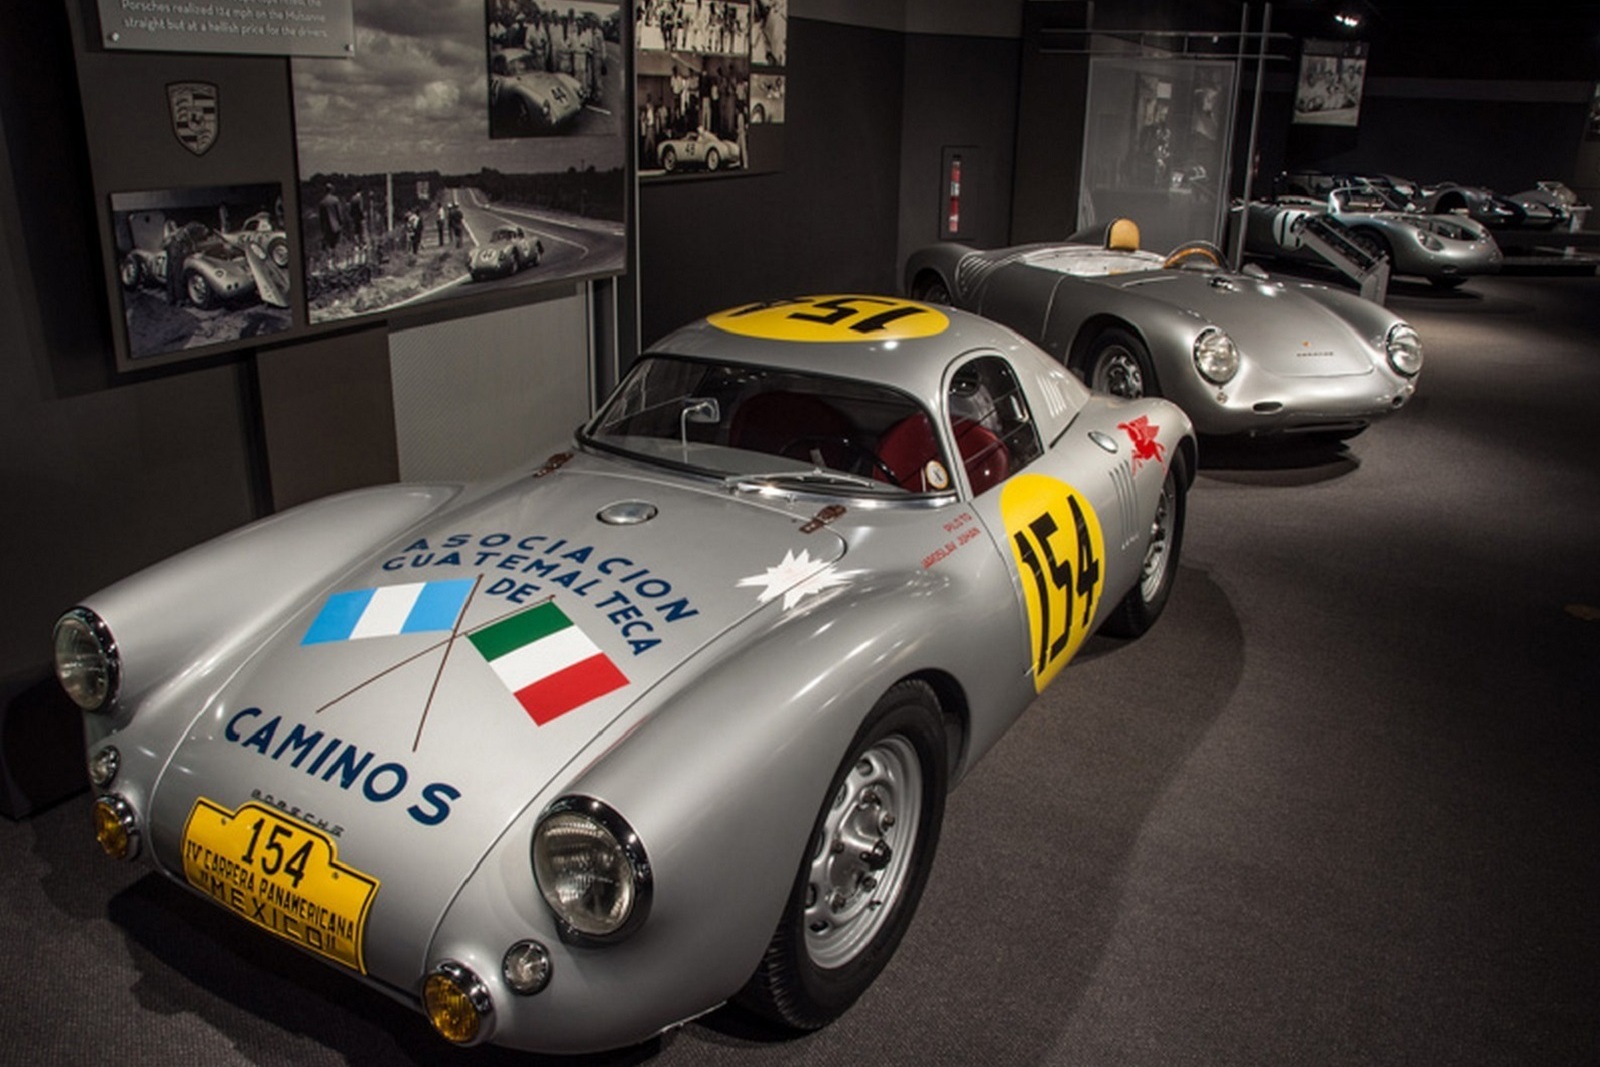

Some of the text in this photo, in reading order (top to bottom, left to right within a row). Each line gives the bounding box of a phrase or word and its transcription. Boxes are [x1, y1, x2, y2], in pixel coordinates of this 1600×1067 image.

[124, 16, 165, 31] straight
[166, 18, 185, 31] but
[187, 20, 198, 32] at
[241, 23, 264, 36] price
[265, 23, 279, 36] for
[281, 24, 296, 36] the
[269, 9, 284, 20] the
[402, 533, 700, 623] ASOCIACION
[485, 577, 541, 604] DE
[1014, 494, 1099, 677] 154
[224, 707, 462, 826] CAMINOS
[251, 788, 345, 838] PORSCHE
[241, 818, 315, 889] 154
[203, 848, 255, 894] CARRERA
[259, 877, 355, 938] PANAMERICANA
